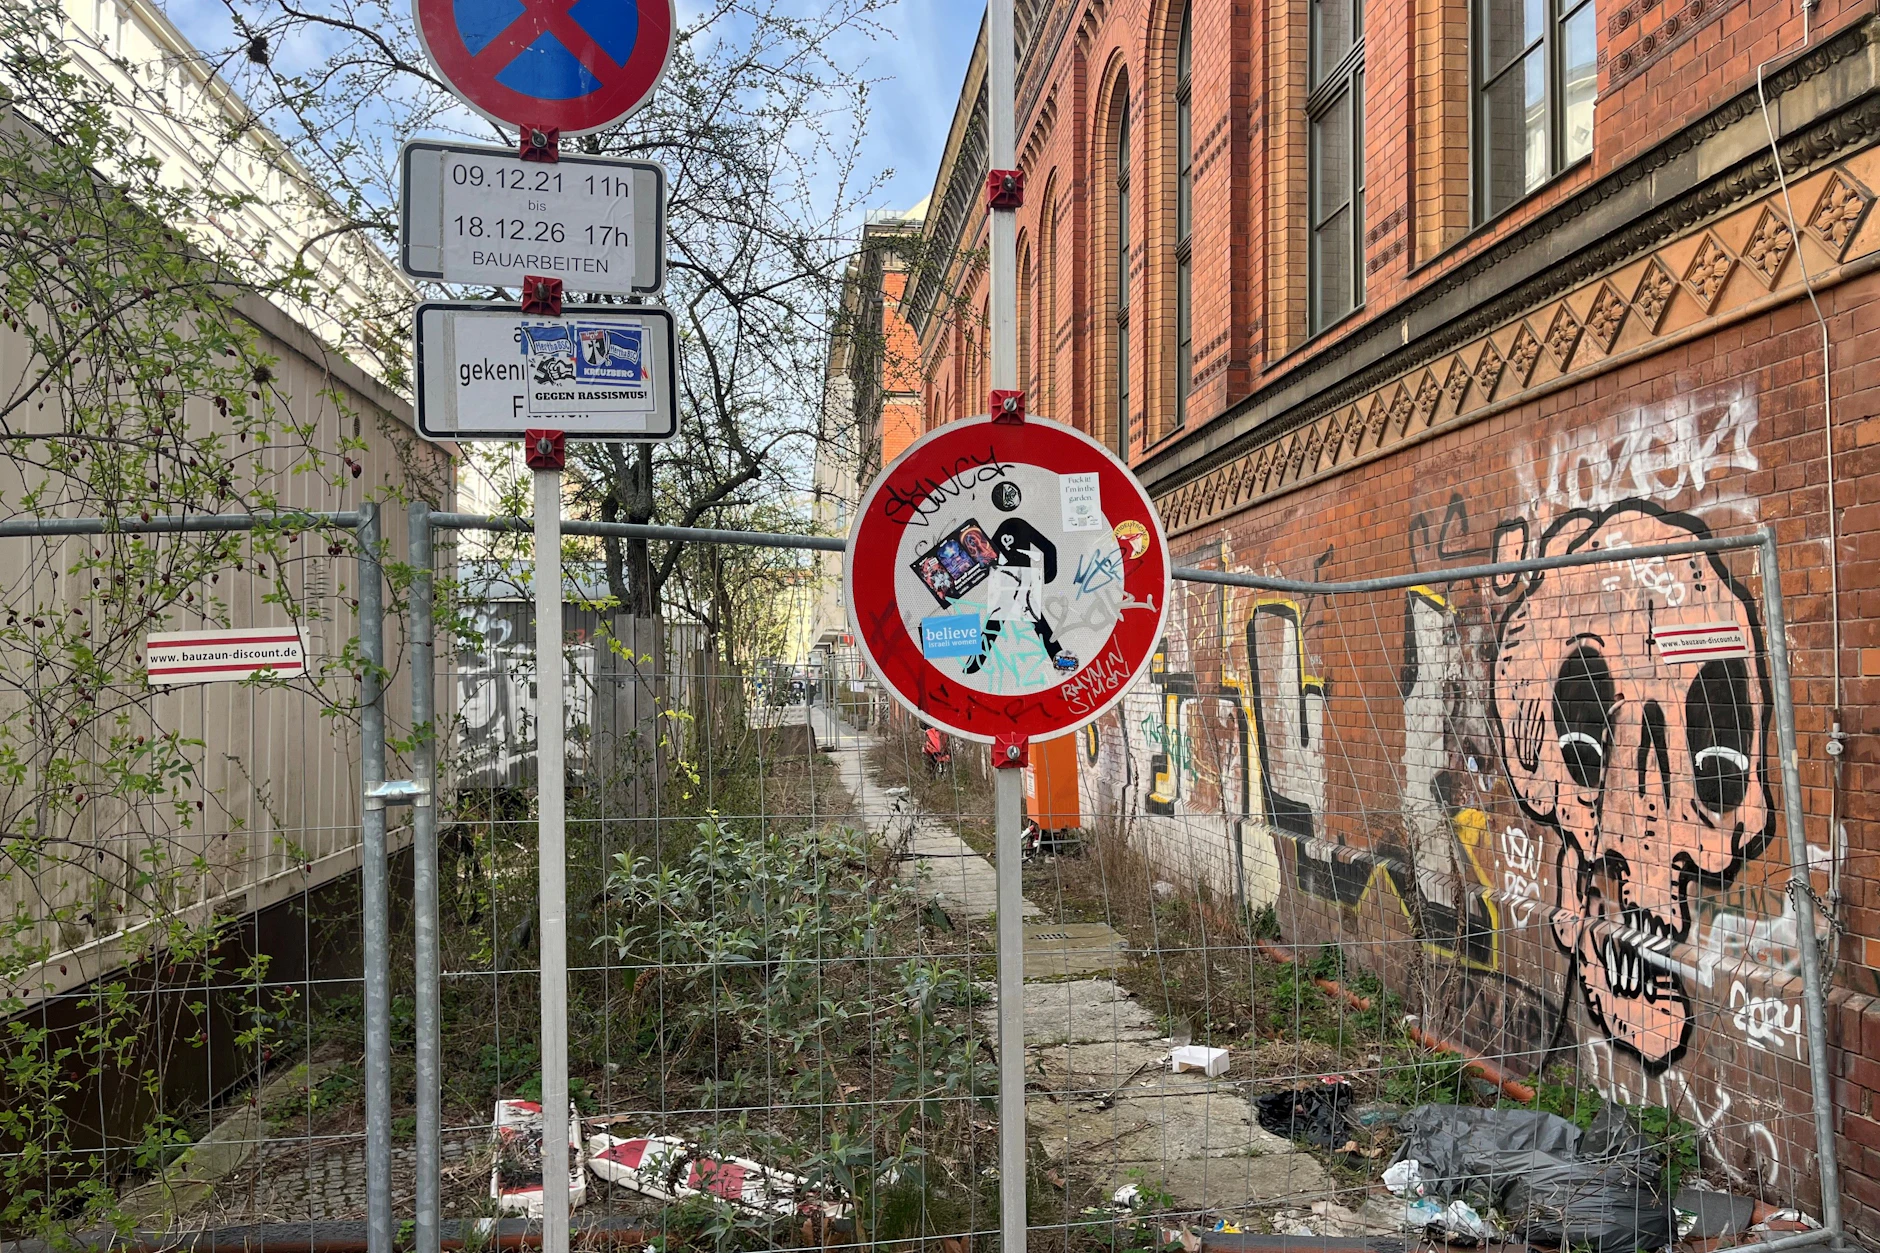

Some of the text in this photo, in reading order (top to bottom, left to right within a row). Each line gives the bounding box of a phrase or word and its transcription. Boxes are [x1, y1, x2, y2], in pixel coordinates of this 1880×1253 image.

[452, 164, 629, 198] 09.12.21 11h
[528, 200, 547, 212] bis
[454, 215, 628, 247] 18.12.26 17h
[472, 250, 609, 274] BAUARBEITEN
[583, 366, 634, 379] KREUZBERG
[535, 390, 648, 401] GEGEN RASSISMUS!
[926, 627, 977, 641] believe
[928, 637, 977, 648] israeli women
